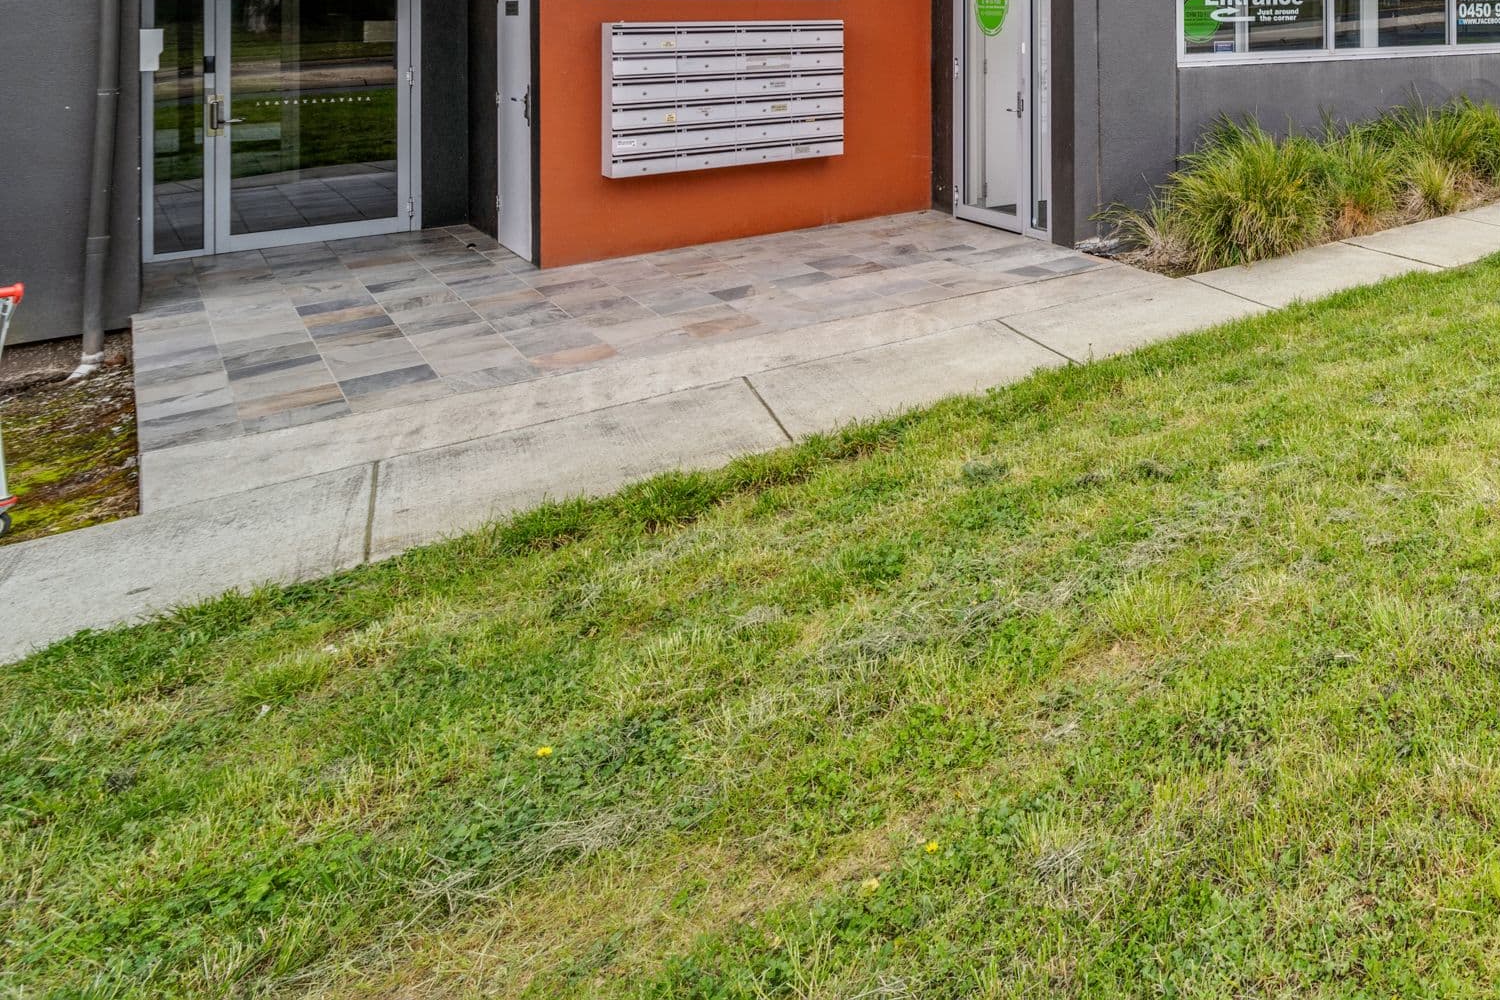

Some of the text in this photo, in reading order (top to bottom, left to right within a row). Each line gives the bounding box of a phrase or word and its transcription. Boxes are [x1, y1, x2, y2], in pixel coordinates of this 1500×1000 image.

[1256, 8, 1273, 16] Just
[1458, 2, 1492, 18] 0450
[1260, 14, 1272, 22] the
